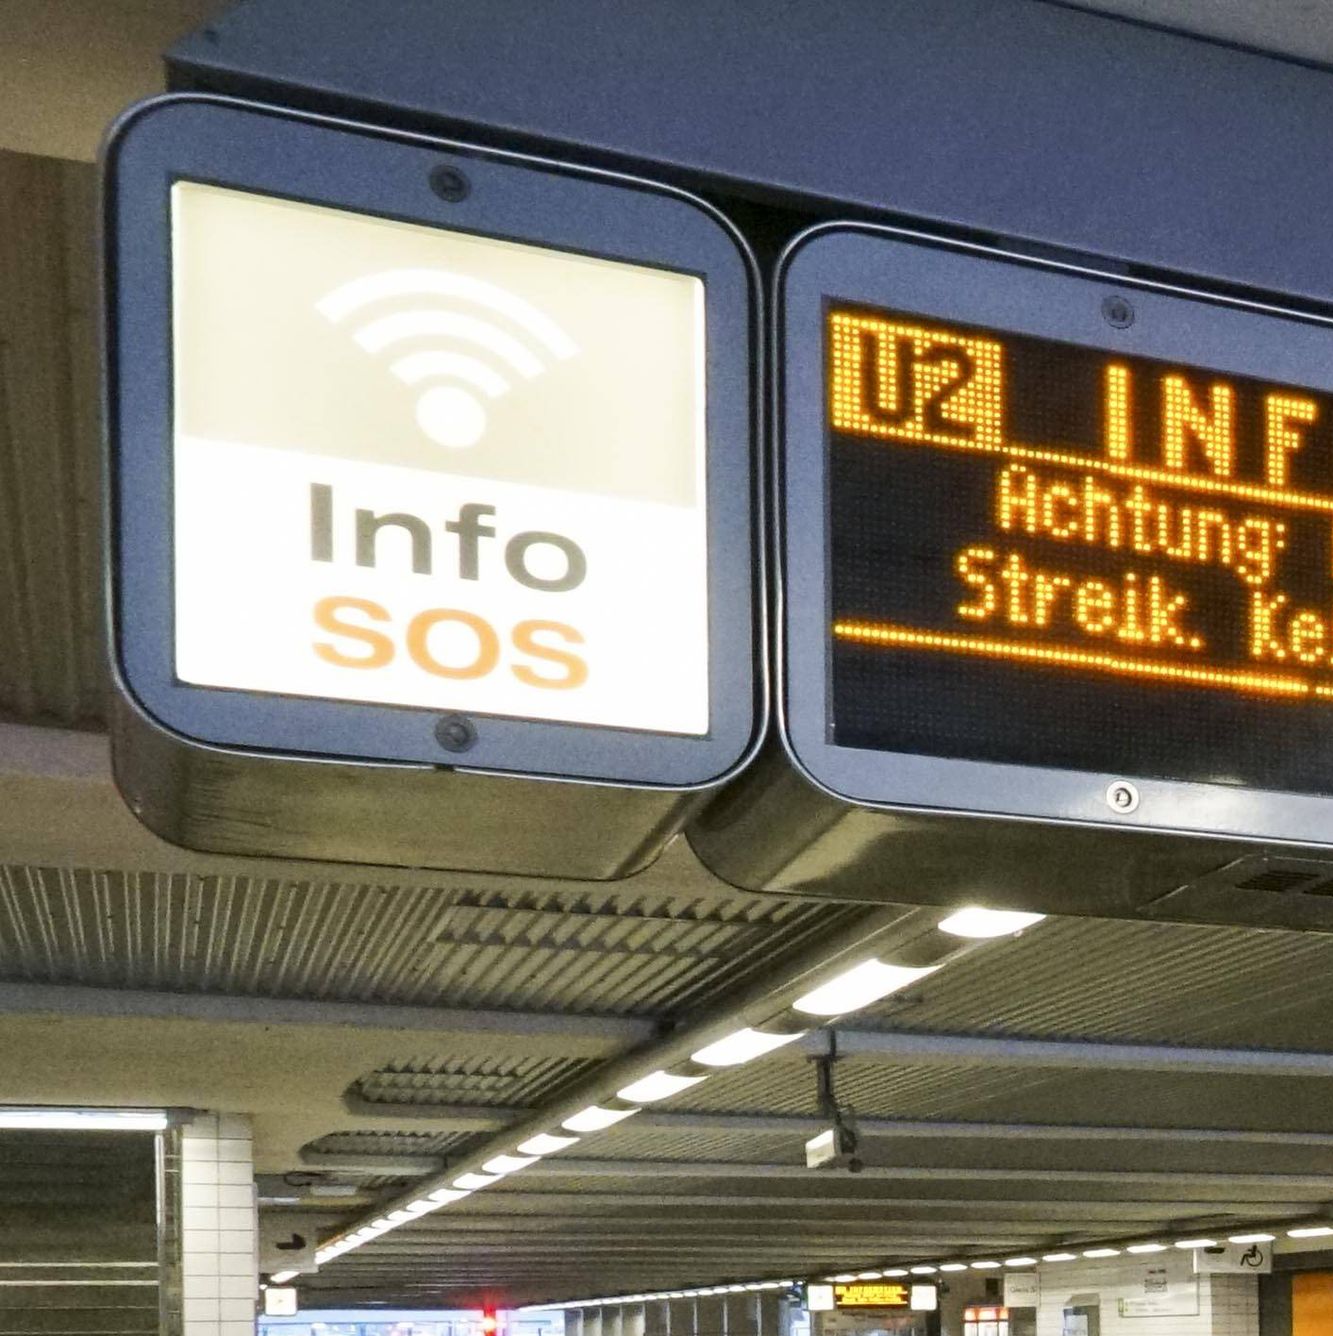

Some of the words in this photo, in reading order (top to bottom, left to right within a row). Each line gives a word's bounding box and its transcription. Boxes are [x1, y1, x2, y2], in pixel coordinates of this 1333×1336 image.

[859, 326, 978, 434] U2
[309, 482, 588, 593] Info
[998, 463, 1286, 584] Achtung:
[311, 596, 589, 690] SOS
[955, 547, 1202, 648] Streik.
